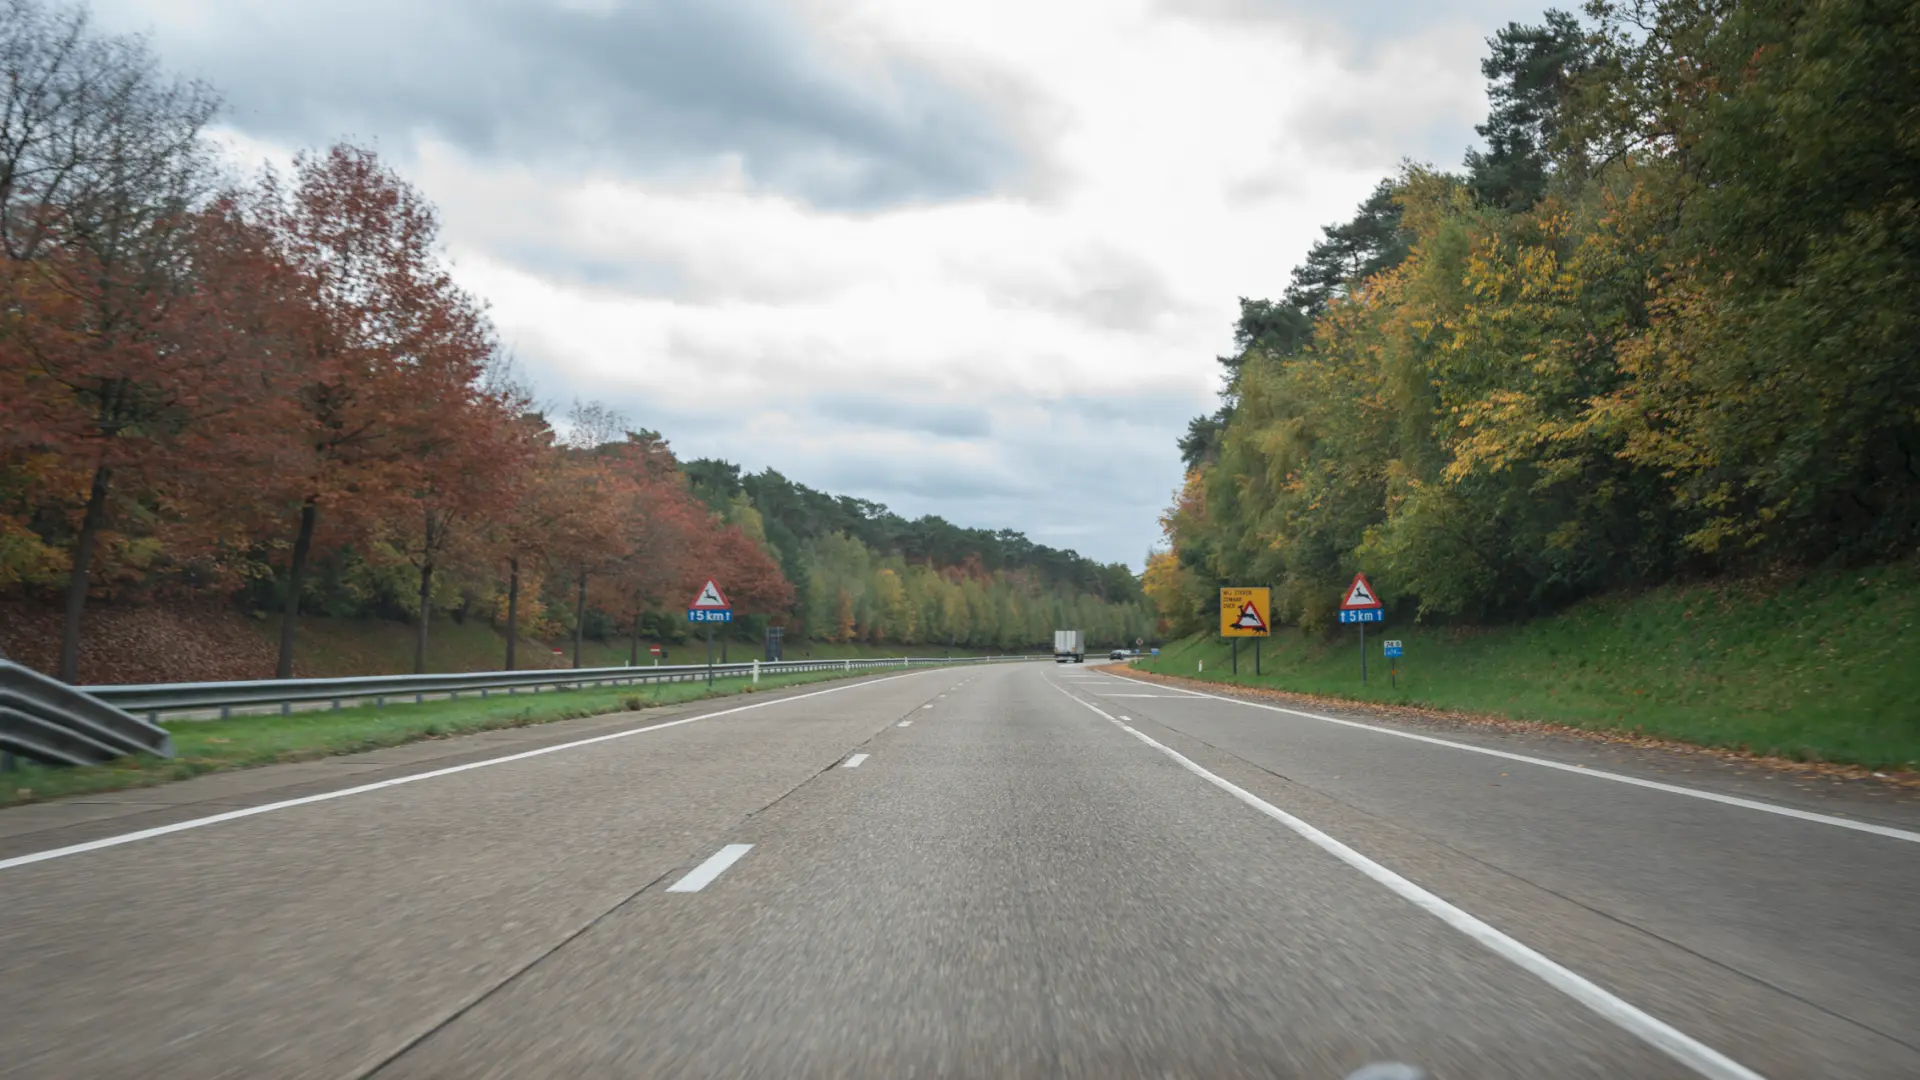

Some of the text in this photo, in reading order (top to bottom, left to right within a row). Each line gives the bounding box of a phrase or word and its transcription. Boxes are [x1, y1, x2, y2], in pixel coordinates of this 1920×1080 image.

[696, 610, 724, 621] 5 km
[1349, 610, 1374, 622] 5 km
